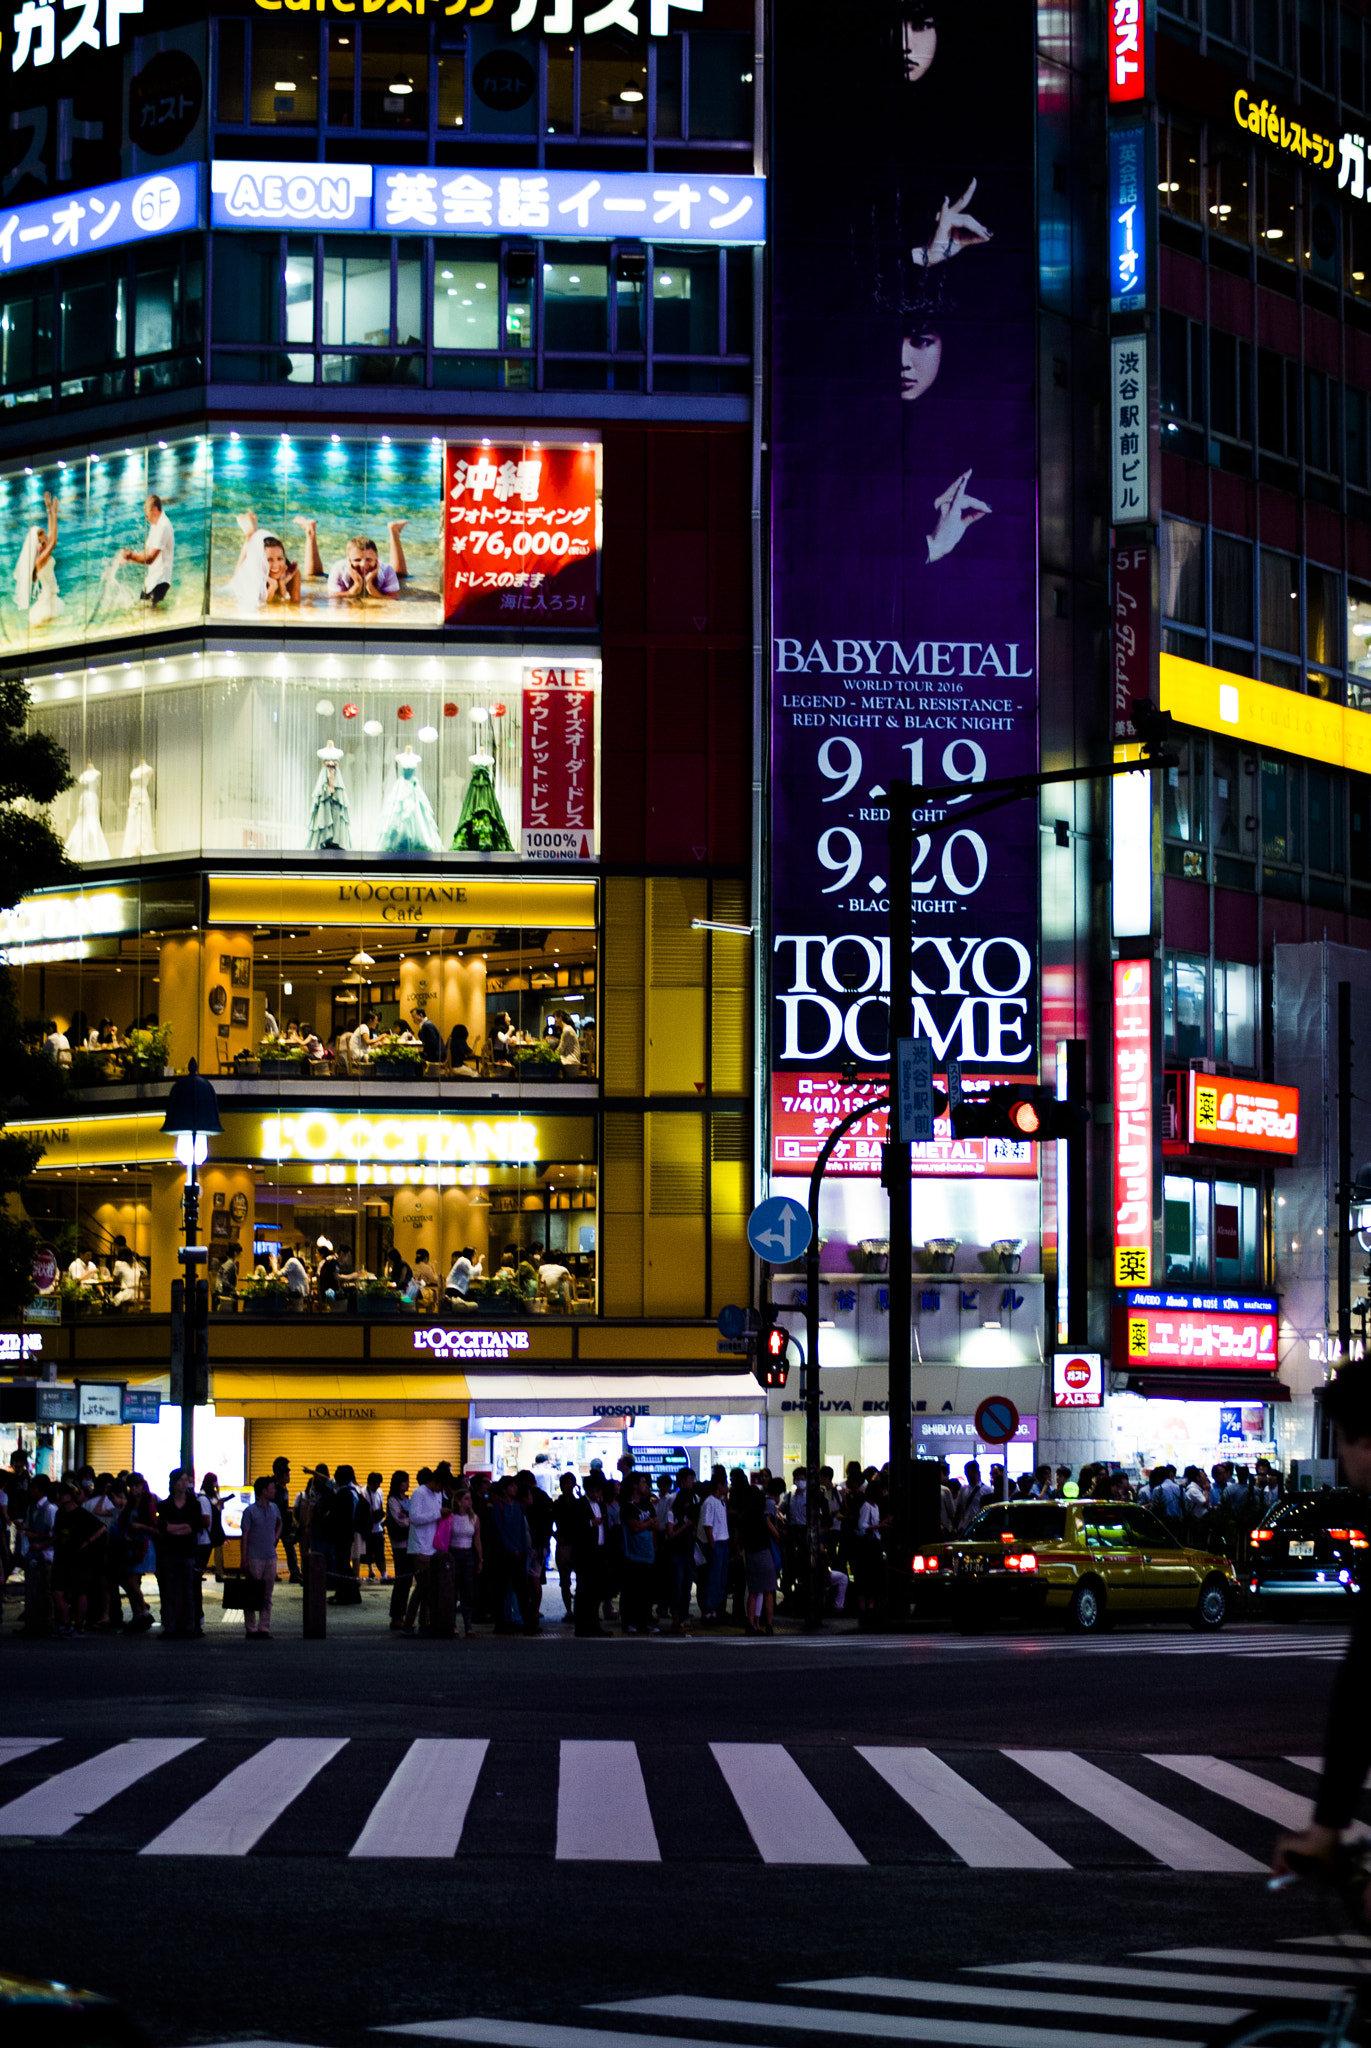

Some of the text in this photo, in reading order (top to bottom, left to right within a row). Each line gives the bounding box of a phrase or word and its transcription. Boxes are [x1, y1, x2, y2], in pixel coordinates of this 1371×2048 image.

[140, 187, 172, 222] 6F
[230, 174, 351, 213] AEON
[386, 172, 753, 229] 英会話イーオン
[1119, 352, 1140, 509] 渋谷駅前ビル
[450, 457, 542, 502] 沖縄
[449, 506, 591, 526] フォトウェディング
[455, 571, 545, 588] ドレスのまま
[774, 638, 1033, 677] BABYMETAL
[531, 669, 587, 687] SALE
[843, 679, 963, 693] WORLD TOUR 2016
[783, 695, 1013, 712] LEGEND METAL RESISTANCE
[793, 713, 1014, 731] RED NIGHT & BLACK NIGHT
[1248, 704, 1371, 758] studio yogg
[530, 691, 549, 827] アウトレットドレス
[565, 692, 585, 827] サイズオーダードレス
[817, 736, 987, 805] 9.19
[526, 833, 577, 847] 1000%
[817, 827, 988, 896] 9.20
[339, 881, 467, 903] L'OCCITANE
[382, 905, 424, 922] Café
[849, 899, 890, 912] BLAC
[774, 935, 1031, 996] TOKYO
[776, 994, 1032, 1062] DOME
[912, 1046, 930, 1134] 渋谷駅前
[1120, 1252, 1146, 1281] 薬
[414, 1328, 529, 1349] L'OCCITANE
[308, 1407, 376, 1418] L'OCCITANE
[592, 1405, 650, 1416] KIOSQUE
[781, 1401, 852, 1411] SHIUYA
[922, 1424, 964, 1435] SHIBUYA
